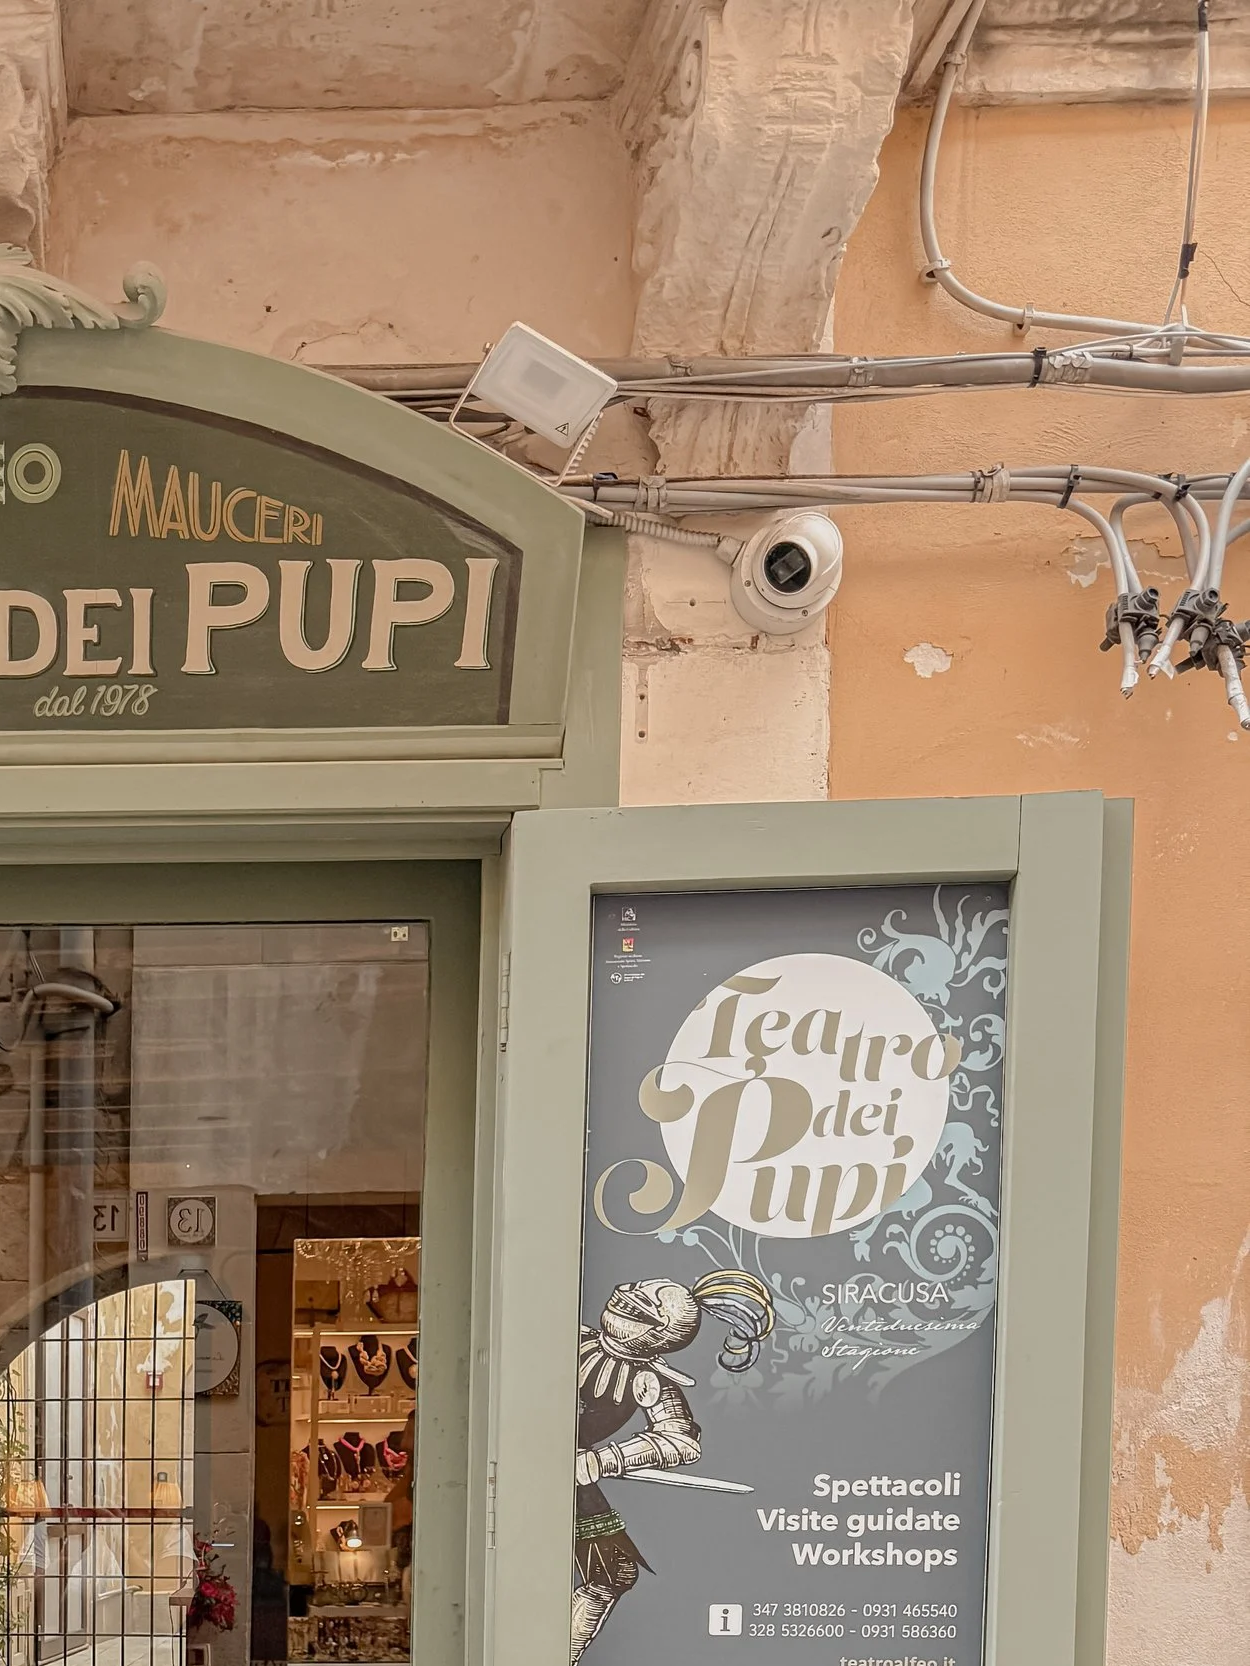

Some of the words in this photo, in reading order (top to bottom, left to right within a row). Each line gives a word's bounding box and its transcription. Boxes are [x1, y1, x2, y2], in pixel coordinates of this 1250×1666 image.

[109, 449, 324, 546] MAUCERI
[181, 557, 499, 675] PUPI
[34, 685, 88, 718] dal
[91, 684, 157, 717] 1978
[694, 975, 961, 1083] Teatro
[812, 1087, 903, 1137] dei
[594, 1061, 914, 1238] Pupi
[822, 1282, 949, 1304] SIRACUSA
[820, 1315, 981, 1333] Ventiduesima
[822, 1338, 920, 1371] Stagione
[812, 1471, 961, 1503] Spettacoli
[756, 1507, 839, 1531] Visite
[846, 1507, 961, 1537] guidate
[791, 1541, 959, 1573] Workshops
[753, 1603, 778, 1617] 347
[783, 1603, 846, 1617] 3810826
[862, 1603, 897, 1618] 0931
[902, 1603, 958, 1618] 465540
[749, 1624, 775, 1637] 328
[780, 1624, 844, 1638] 5326600
[861, 1625, 895, 1638] 0931
[901, 1625, 957, 1639] 586360
